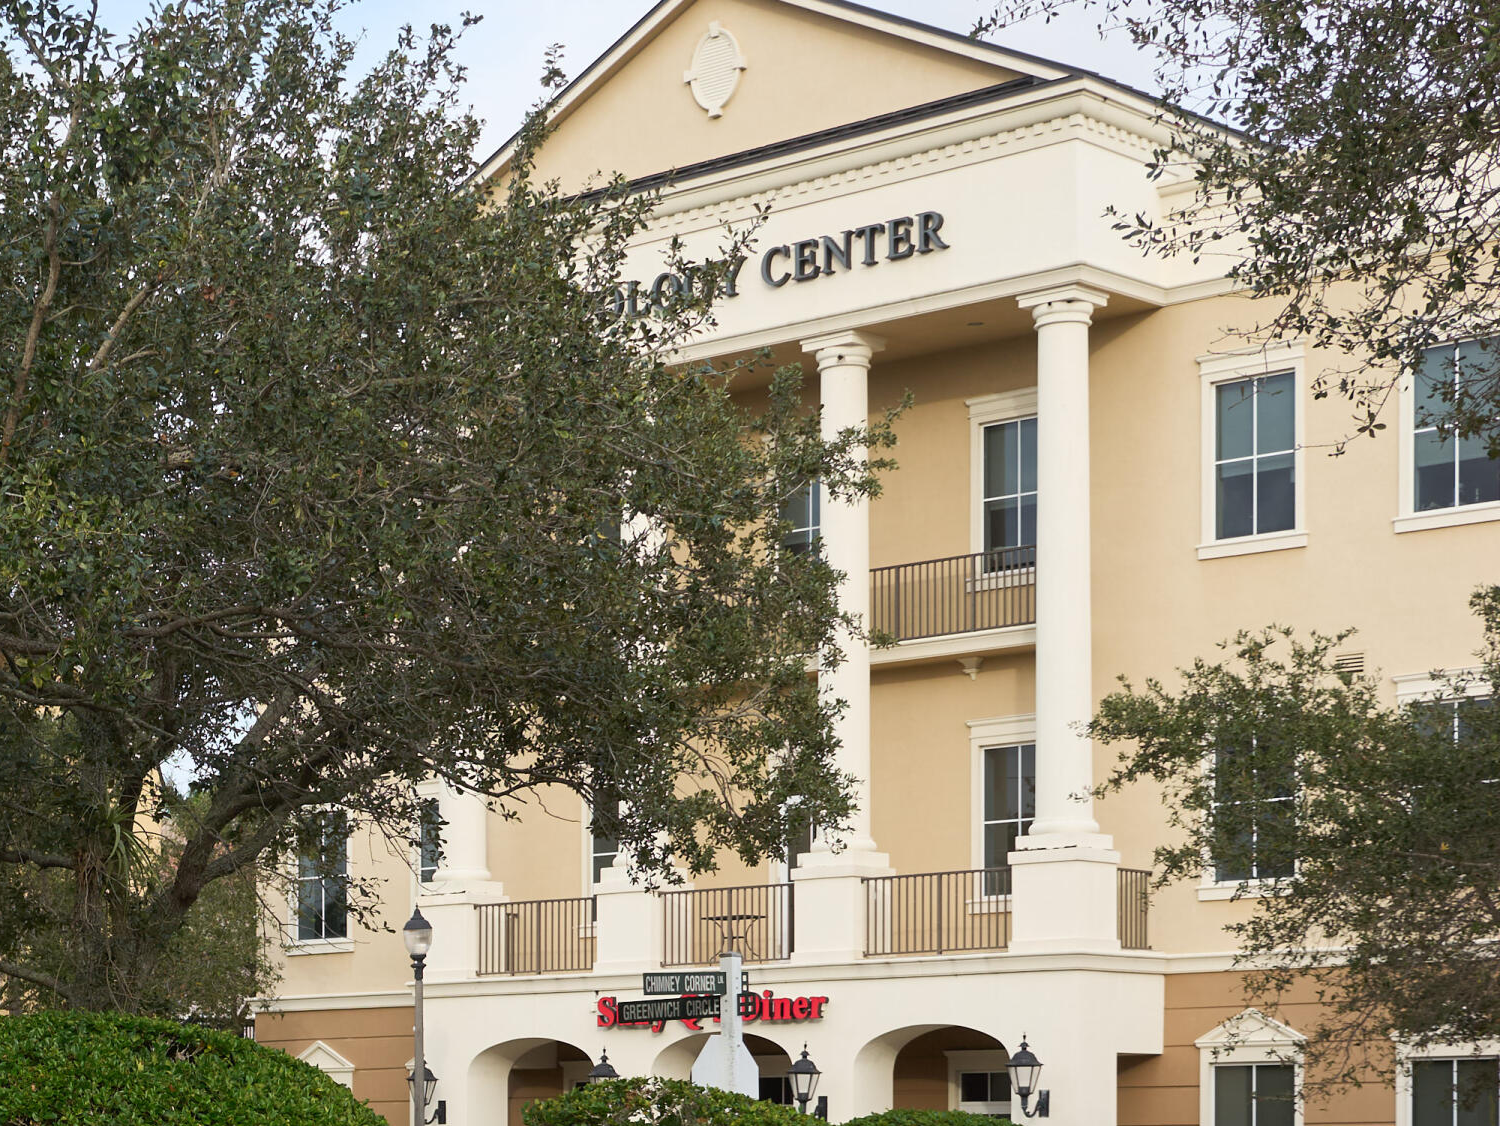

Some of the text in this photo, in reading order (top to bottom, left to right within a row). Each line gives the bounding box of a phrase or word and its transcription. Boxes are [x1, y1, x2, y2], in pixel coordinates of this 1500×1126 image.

[761, 210, 950, 287] CENTER
[645, 975, 680, 993] CHIMNEY
[684, 974, 716, 992] CORNER
[623, 1001, 680, 1021] GREENWICH
[686, 1000, 720, 1017] CIRCLE
